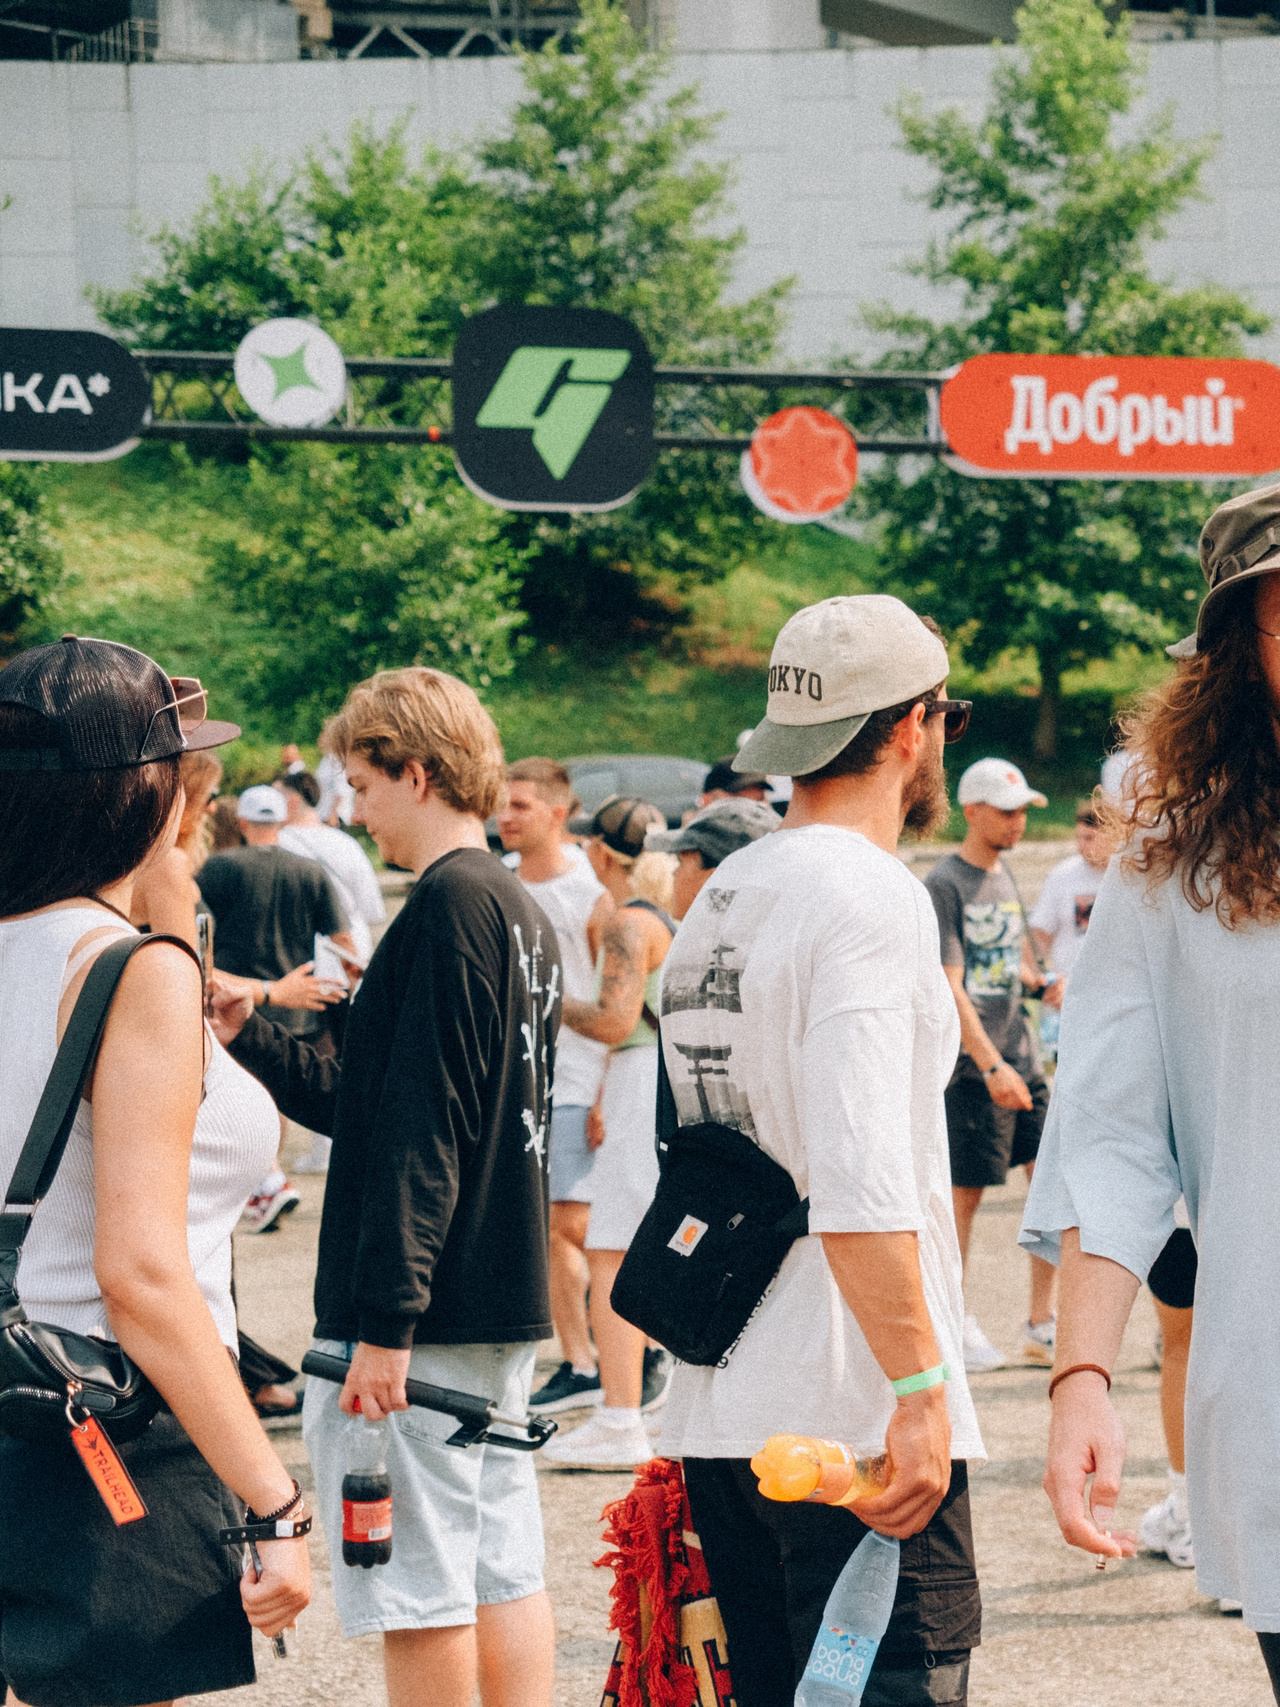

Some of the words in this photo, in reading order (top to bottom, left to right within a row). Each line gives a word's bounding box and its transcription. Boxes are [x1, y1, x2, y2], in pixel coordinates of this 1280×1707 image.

[1003, 374, 1236, 456] Добрый
[767, 664, 823, 702] OKYO
[92, 1449, 134, 1515] TRAILHEAD
[817, 1642, 865, 1673] bona
